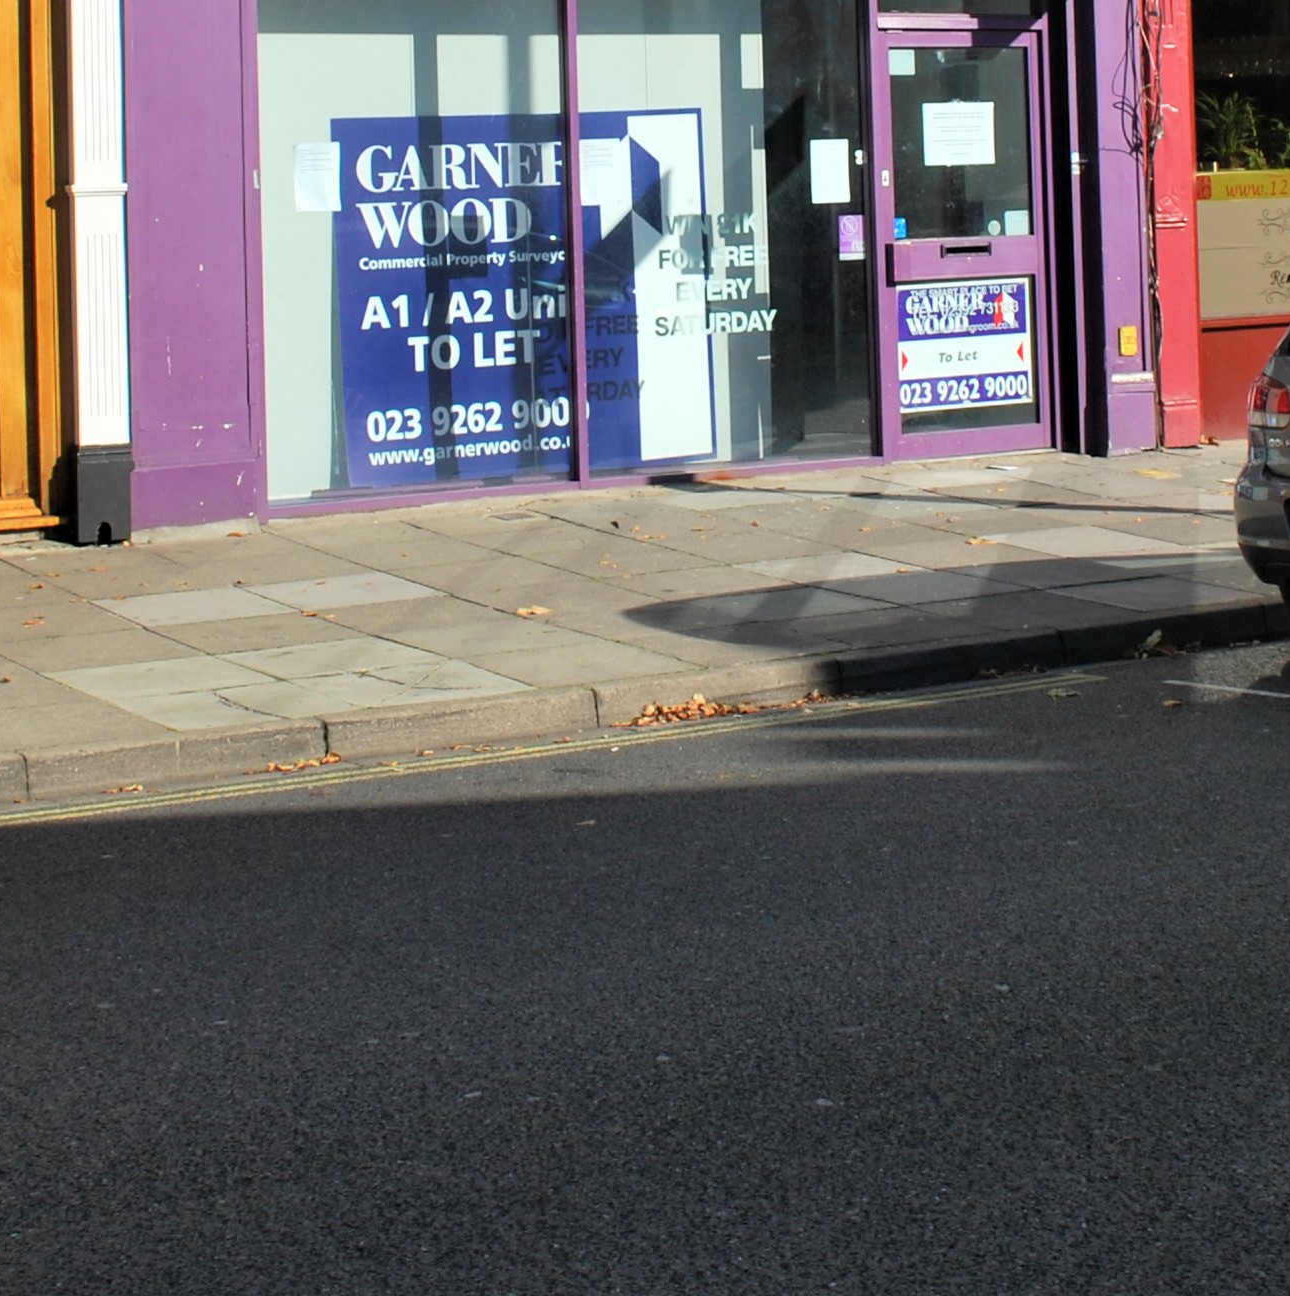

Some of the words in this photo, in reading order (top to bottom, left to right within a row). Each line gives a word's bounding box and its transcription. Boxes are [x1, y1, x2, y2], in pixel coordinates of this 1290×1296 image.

[356, 197, 532, 249] WOOD
[359, 254, 443, 271] Commercial
[446, 251, 506, 267] Property
[676, 278, 752, 302] EVERY
[989, 285, 1000, 294] TO
[361, 294, 409, 330] A1
[422, 293, 434, 326] /
[445, 290, 494, 324] A2
[906, 293, 985, 315] GARNER
[655, 309, 777, 336] SATURDAY
[906, 316, 969, 336] WOOD
[407, 334, 461, 373] TO
[473, 328, 541, 368] LET
[939, 352, 953, 364] To
[958, 351, 978, 362] Let
[900, 382, 932, 405] 023
[937, 378, 981, 402] 9262
[984, 374, 1027, 398] 9000
[366, 408, 422, 443] 023
[432, 401, 503, 436] 9262
[512, 396, 589, 429] 900
[368, 434, 570, 466] www.garnerwood.co.
